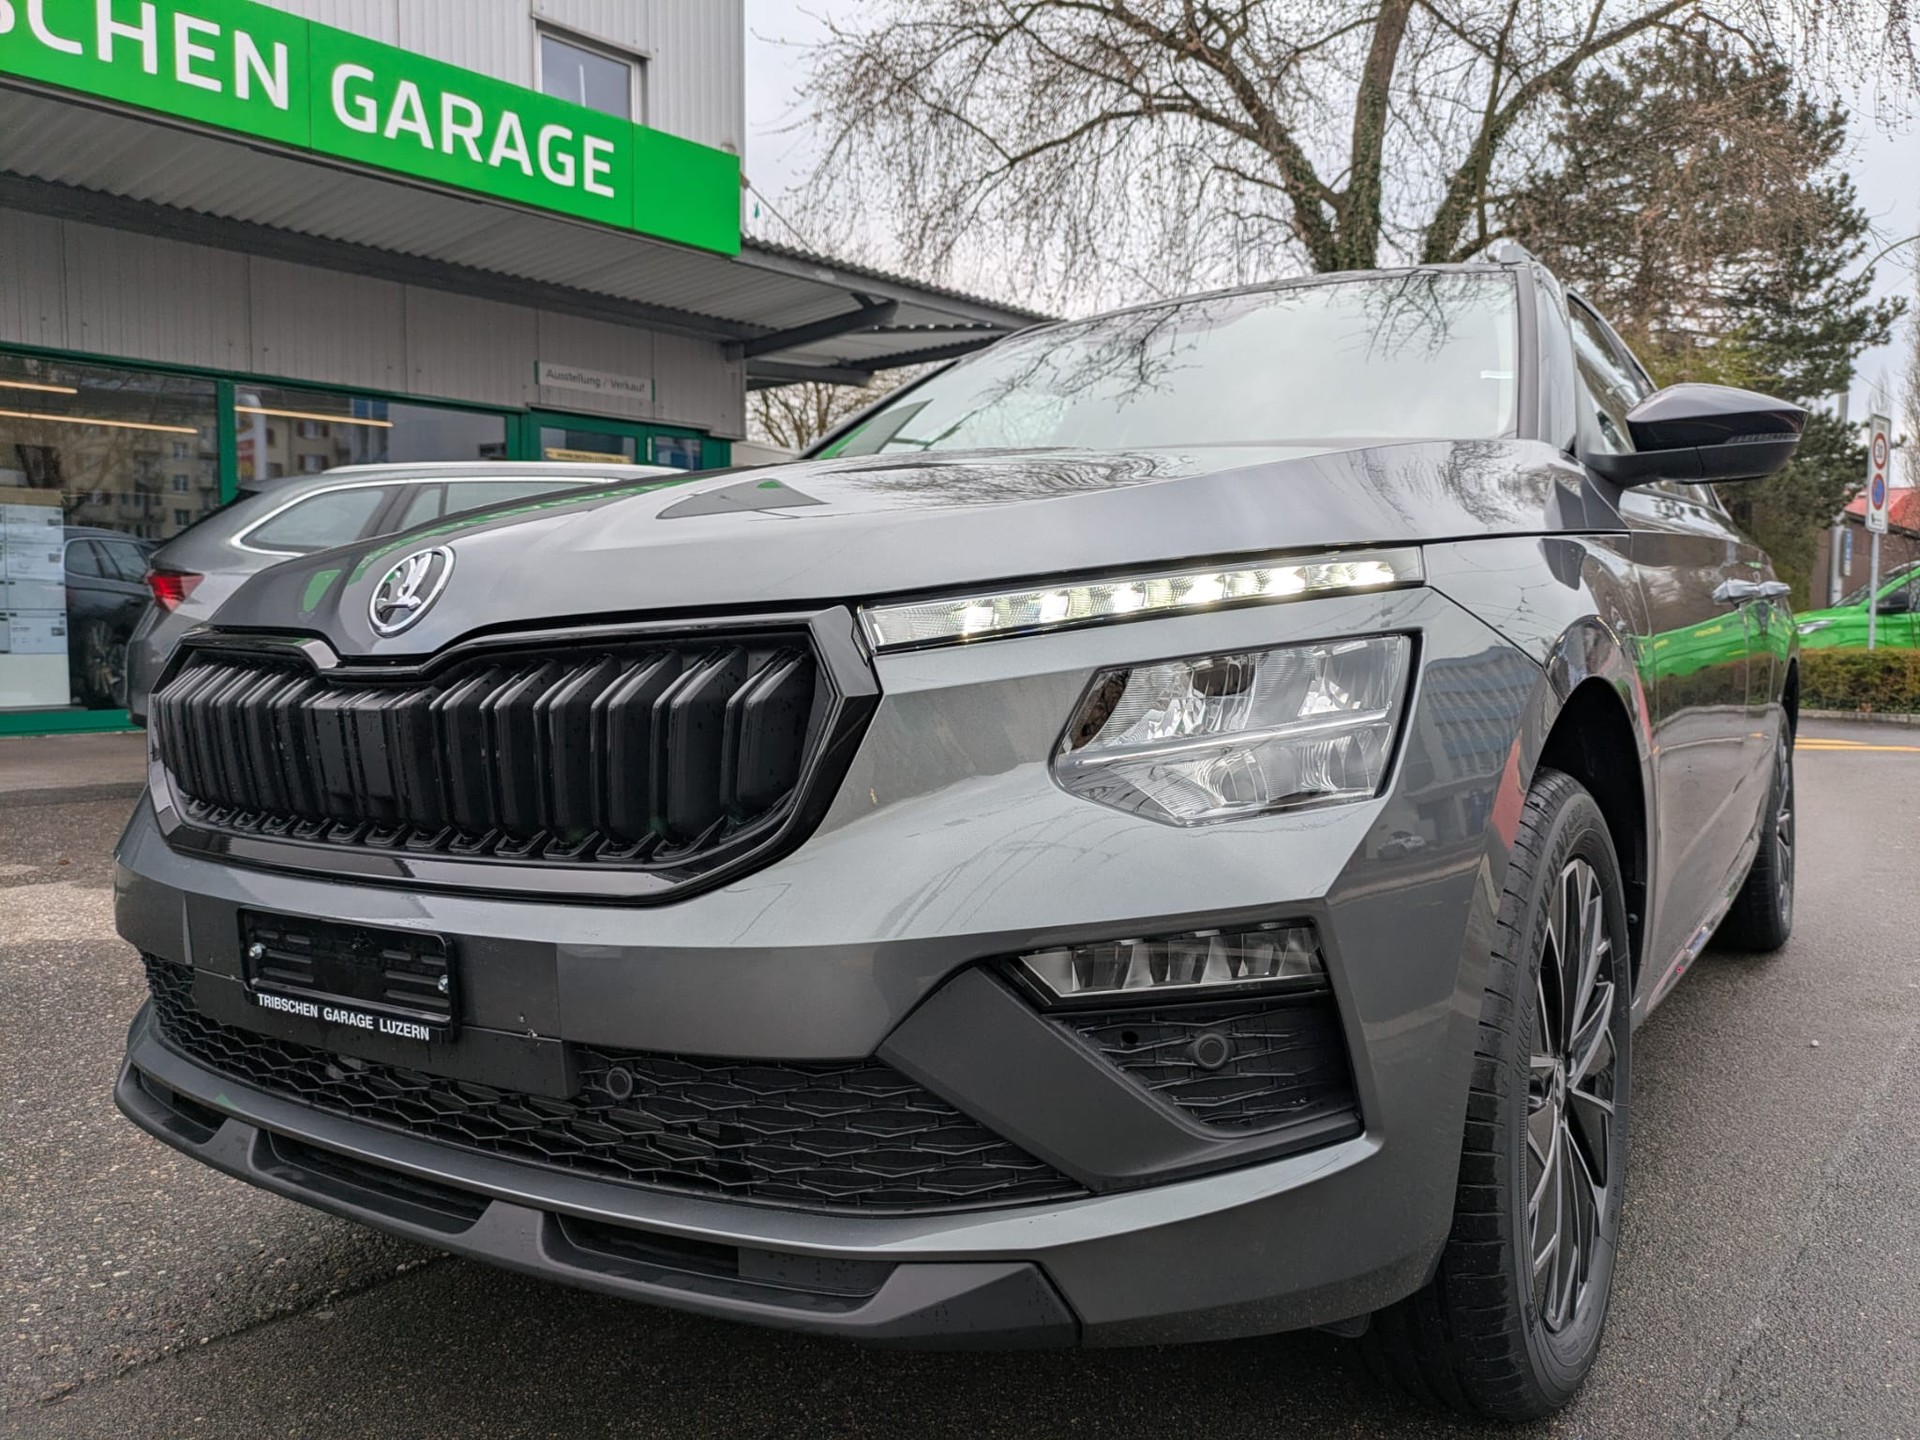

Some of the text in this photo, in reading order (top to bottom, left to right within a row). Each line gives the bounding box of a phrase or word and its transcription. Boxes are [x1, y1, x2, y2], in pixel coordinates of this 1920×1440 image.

[0, 0, 616, 199] CHEN GARAGE
[546, 369, 601, 388] Ausstellung
[610, 379, 645, 393] Verkauf
[257, 993, 430, 1041] TRIBSCHEN GARAGE LUZERN
